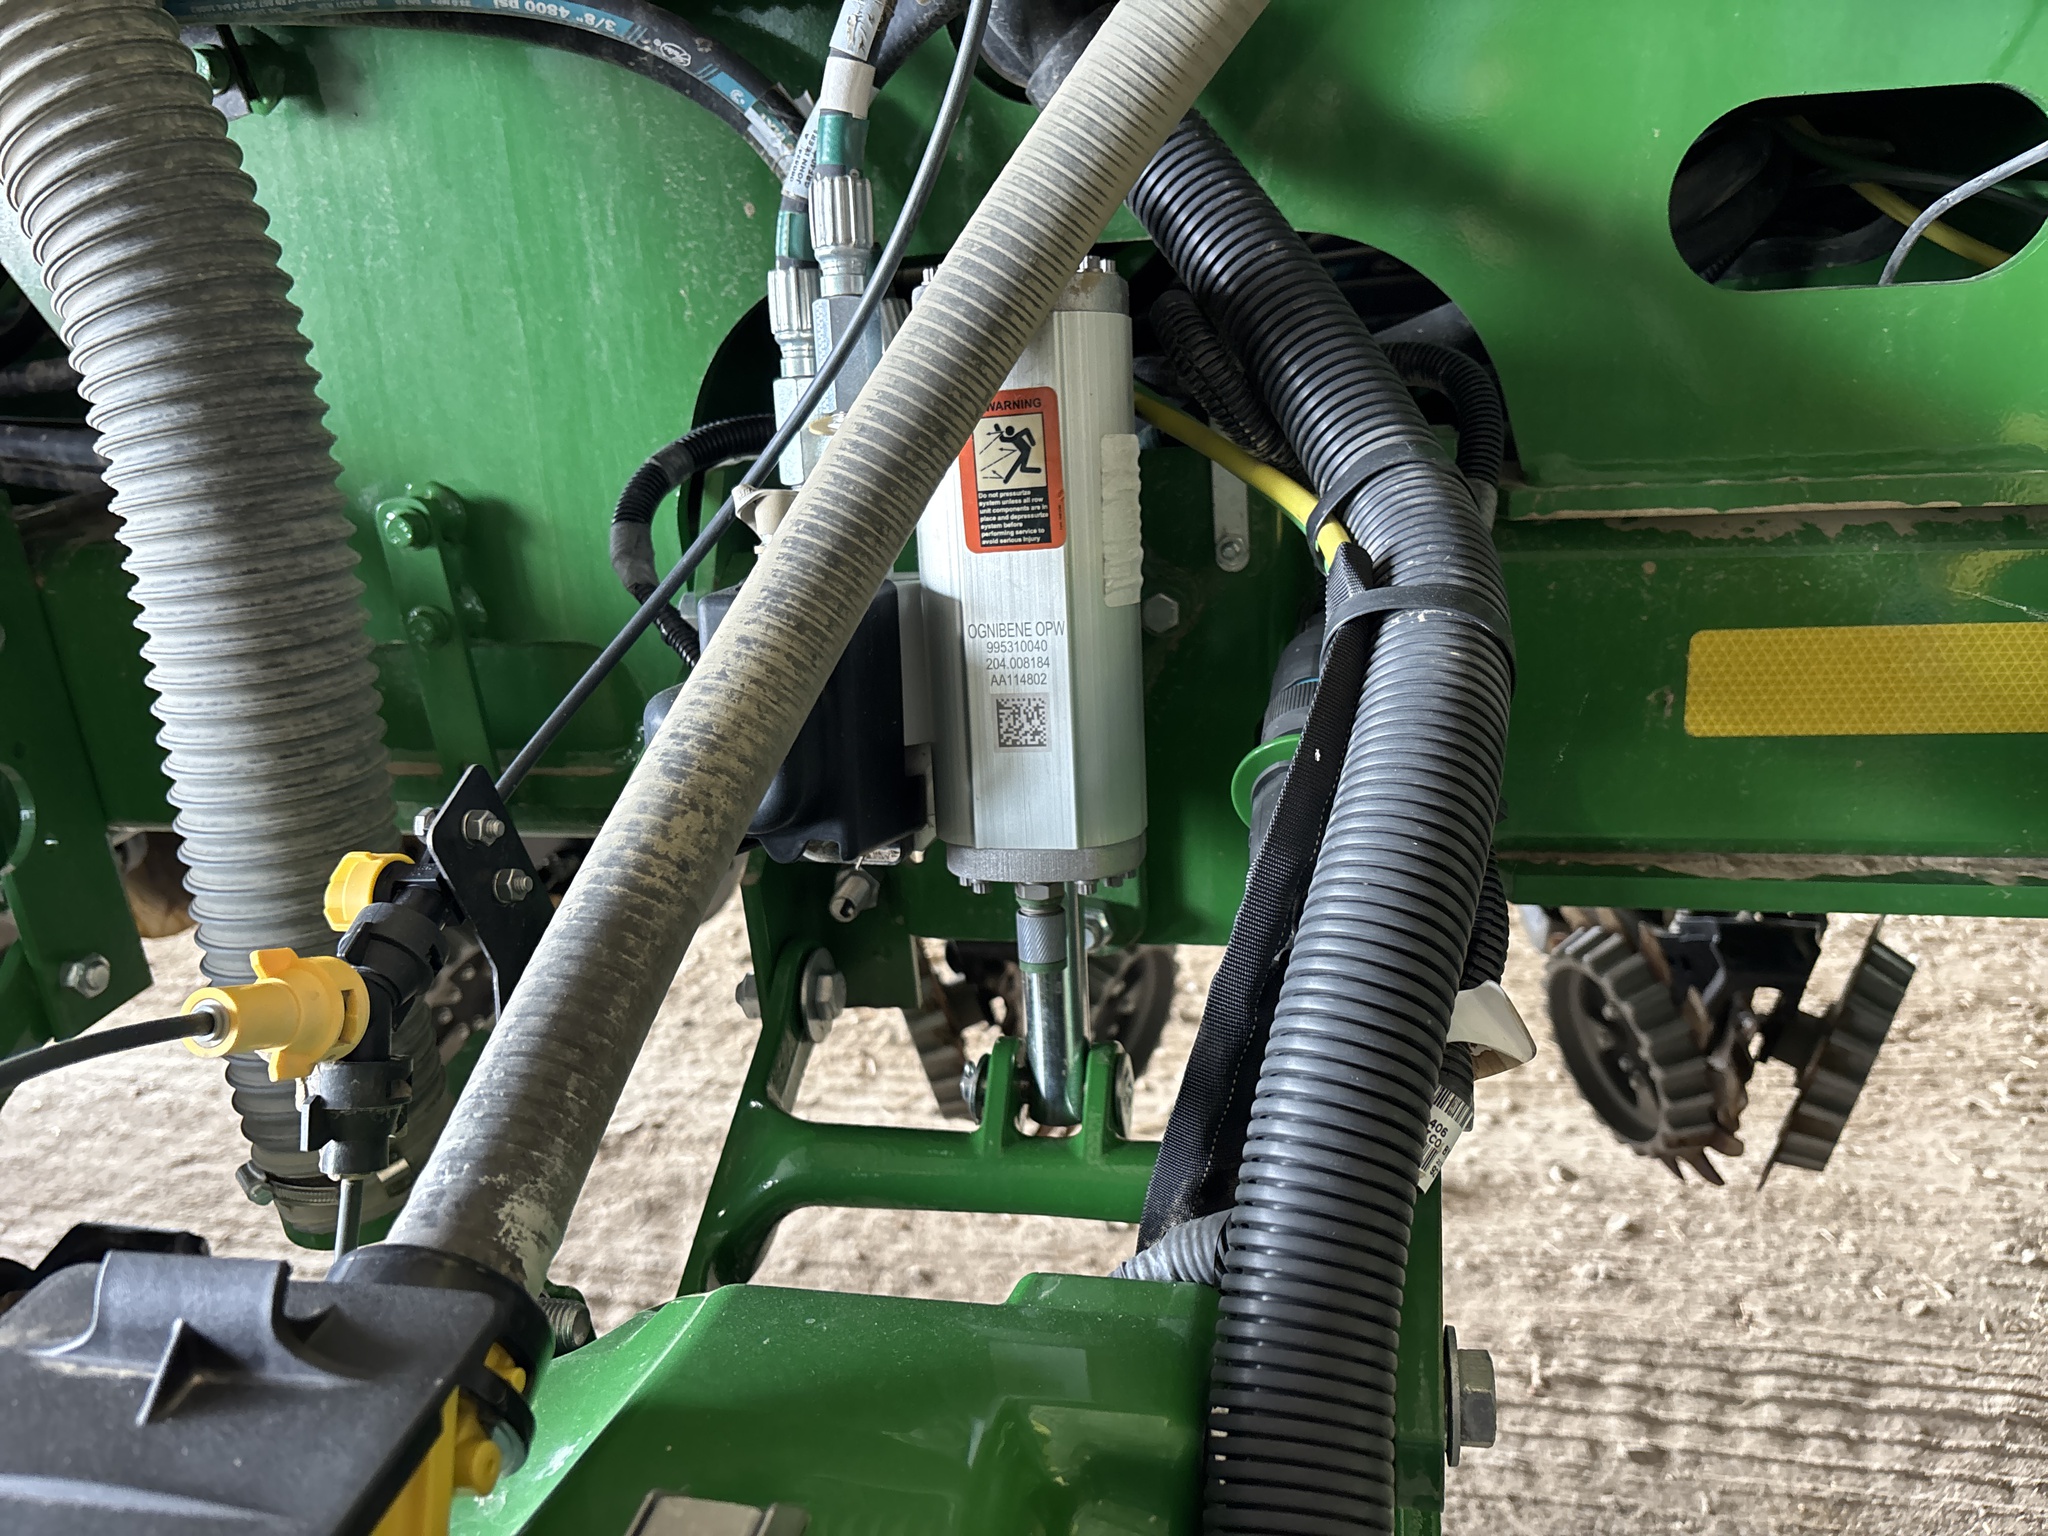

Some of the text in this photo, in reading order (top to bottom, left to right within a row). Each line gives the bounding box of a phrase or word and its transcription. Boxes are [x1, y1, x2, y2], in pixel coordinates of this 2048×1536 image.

[524, 0, 571, 19] 4800
[796, 159, 808, 185] JOHN
[1000, 490, 1032, 498] pressurize
[992, 505, 1030, 514] components
[1010, 511, 1049, 520] depressurize
[1003, 521, 1024, 529] before
[981, 529, 1015, 538] performing
[1015, 528, 1038, 536] service
[968, 620, 1065, 638] OGNIBENE OPW
[986, 639, 1048, 653] 995310040
[986, 656, 1050, 670] 204.008184
[990, 672, 1048, 686] AA114802
